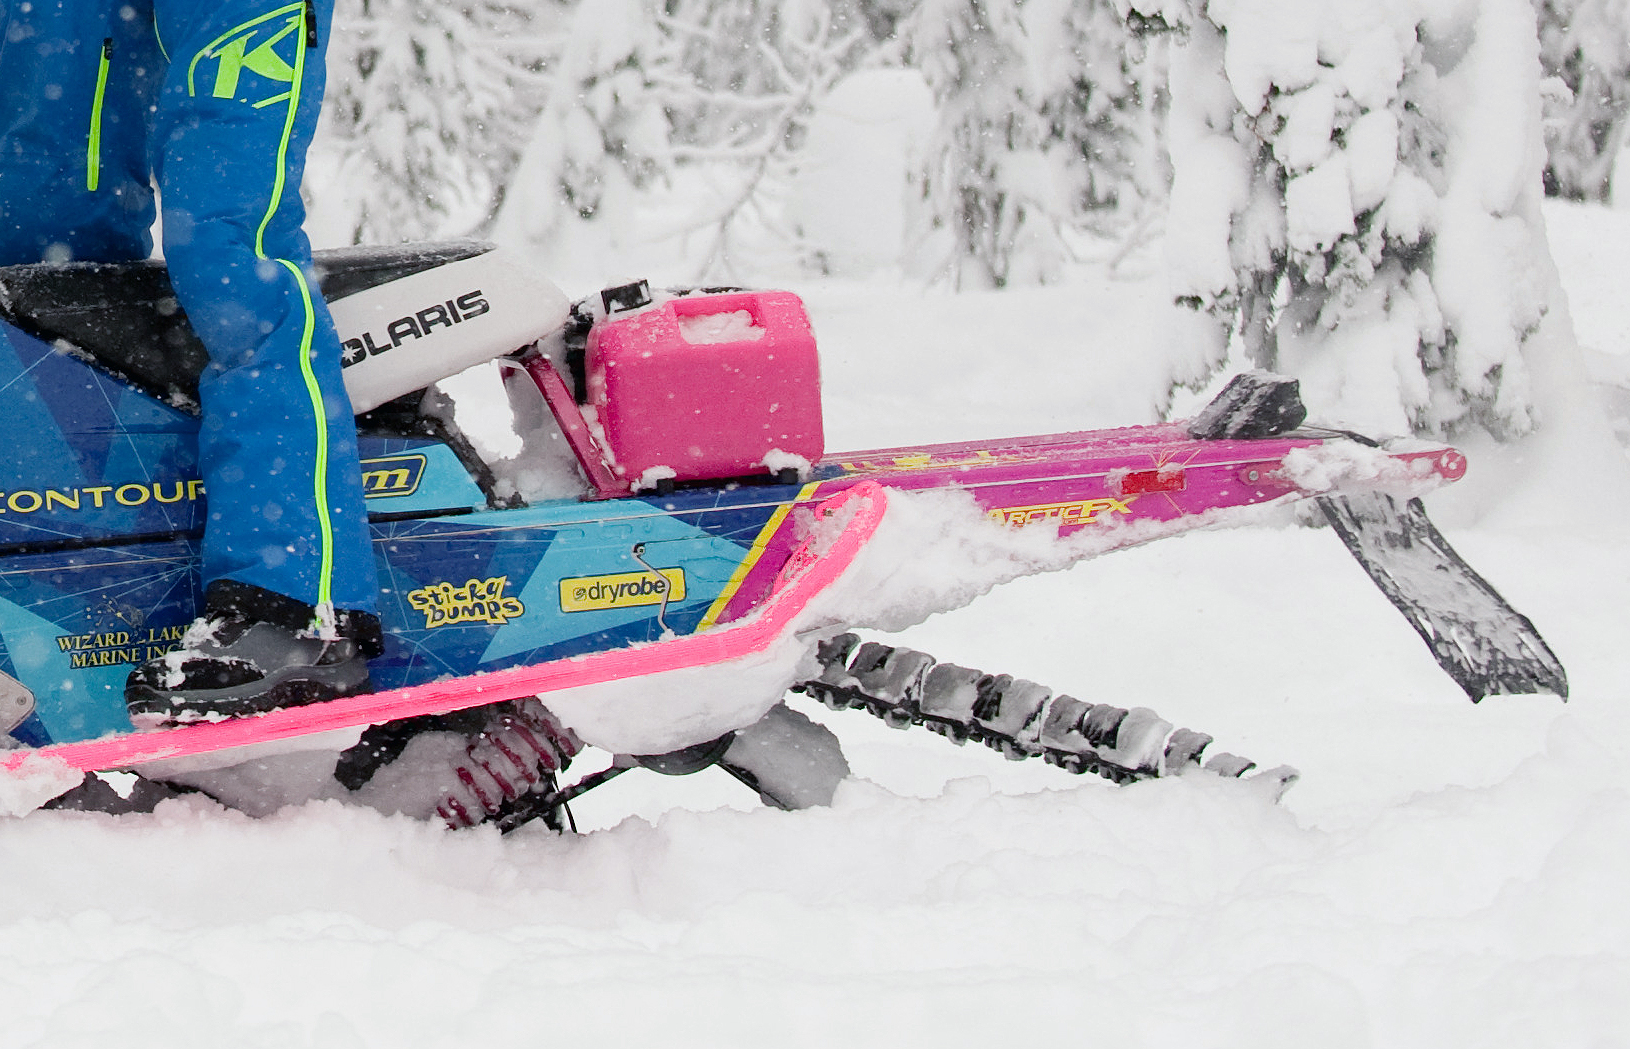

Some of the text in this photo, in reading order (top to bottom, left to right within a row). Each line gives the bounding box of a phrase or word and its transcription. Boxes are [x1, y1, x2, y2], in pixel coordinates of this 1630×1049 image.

[341, 289, 491, 369] OLARIS
[57, 631, 130, 651] WIZARD
[71, 648, 142, 669] MARINE
